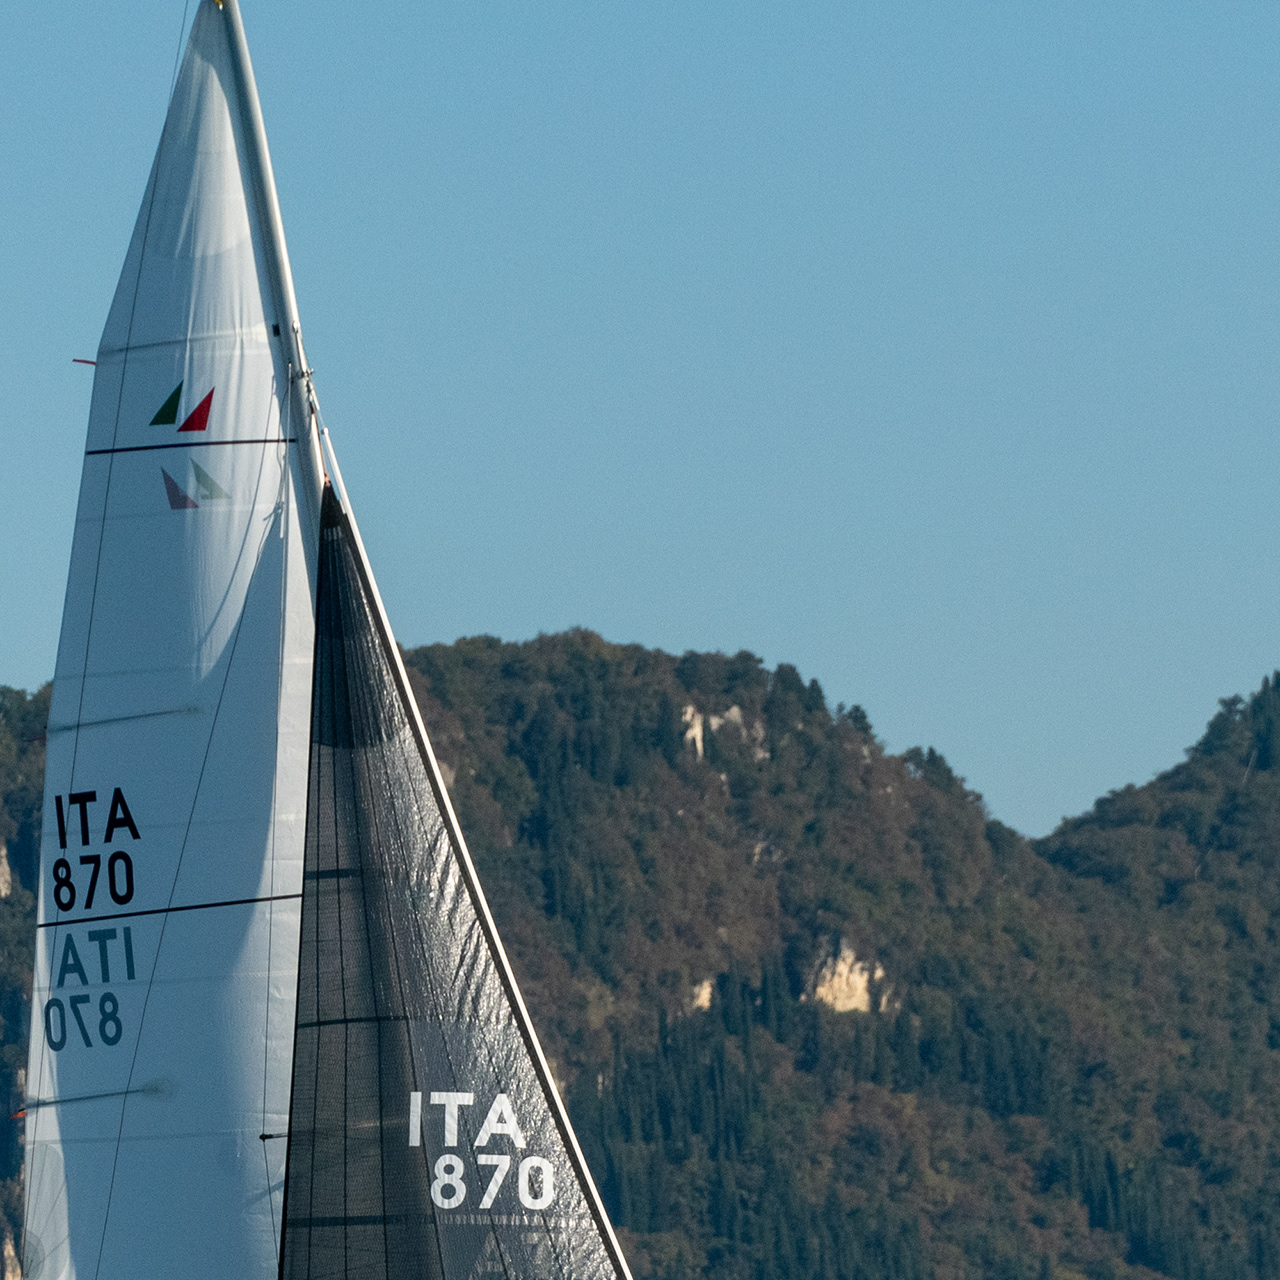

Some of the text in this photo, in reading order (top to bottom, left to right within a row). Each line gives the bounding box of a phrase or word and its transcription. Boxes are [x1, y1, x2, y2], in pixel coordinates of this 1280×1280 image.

[55, 787, 141, 849] ITA
[53, 851, 134, 912] 870
[409, 1092, 526, 1148] ITA
[430, 1155, 554, 1210] 870
